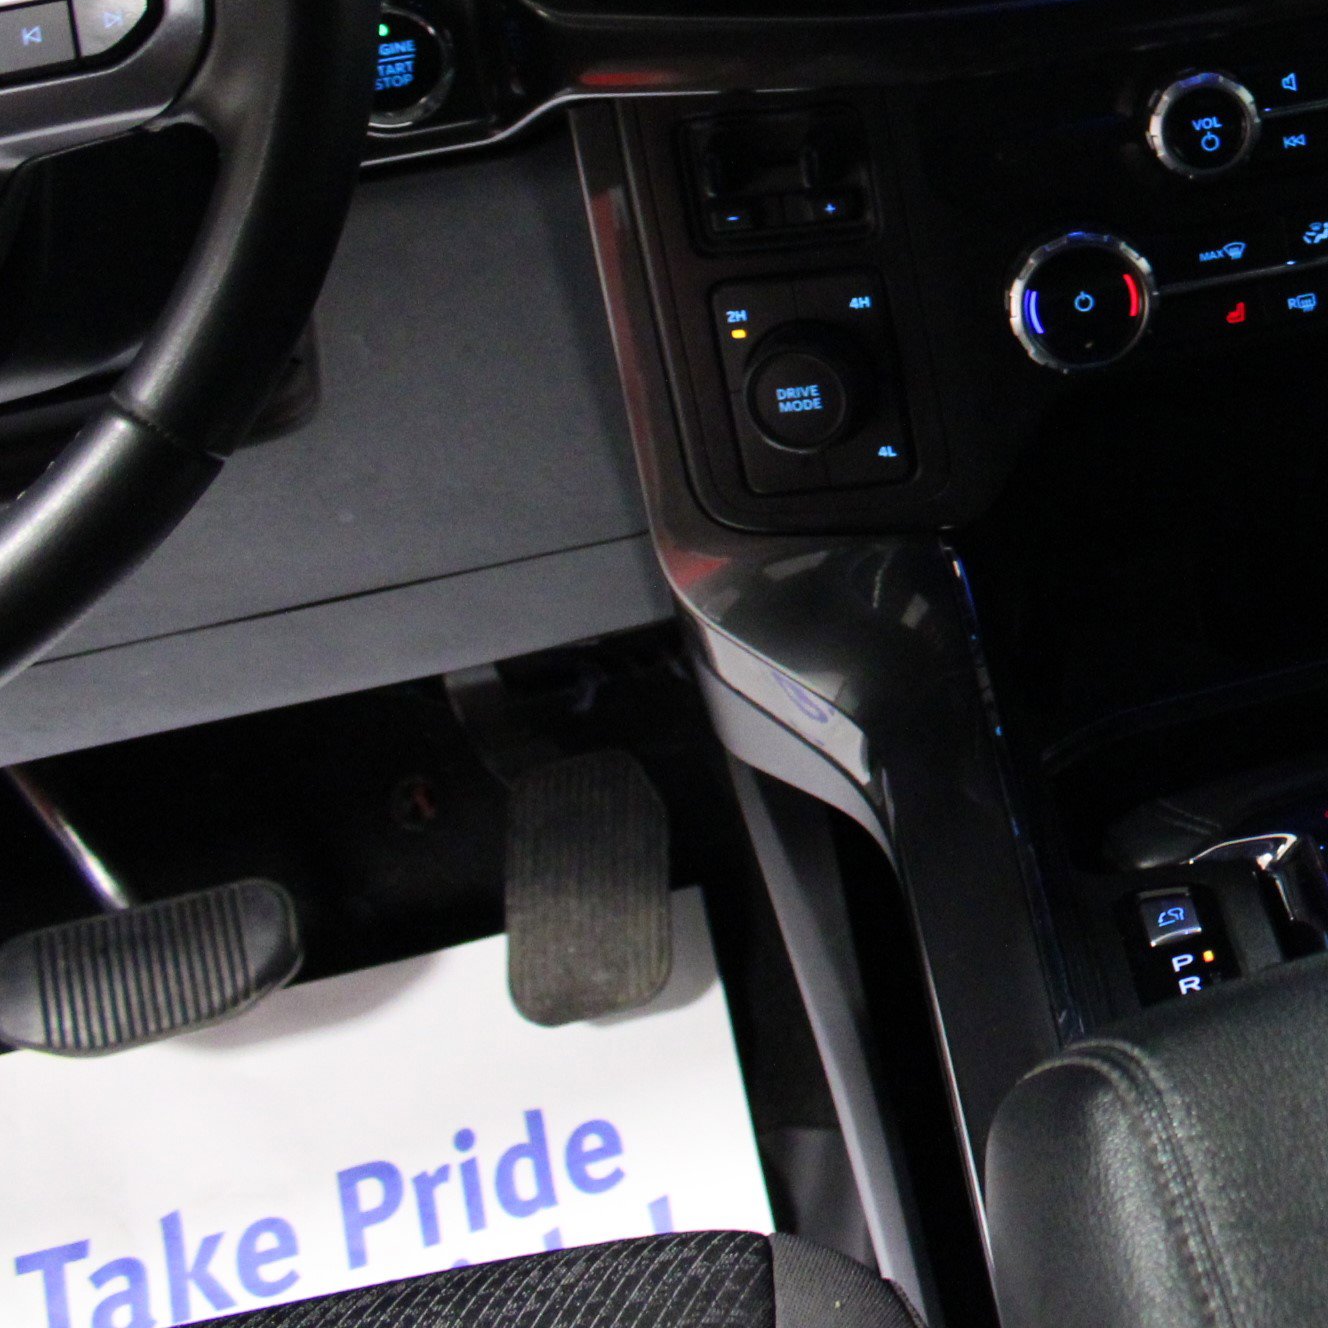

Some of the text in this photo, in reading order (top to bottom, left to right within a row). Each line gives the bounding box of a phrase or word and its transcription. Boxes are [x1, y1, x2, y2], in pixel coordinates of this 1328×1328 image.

[1191, 116, 1223, 131] VOL
[1199, 249, 1225, 263] MAX
[849, 295, 871, 310] 4H
[726, 309, 748, 323] 2H
[776, 384, 820, 401] DRIVE
[778, 397, 823, 413] MODE
[878, 445, 898, 457] 4L
[1172, 954, 1193, 972] P
[1179, 976, 1201, 995] R
[14, 1209, 301, 1328] Take
[337, 1108, 626, 1270] Pride
